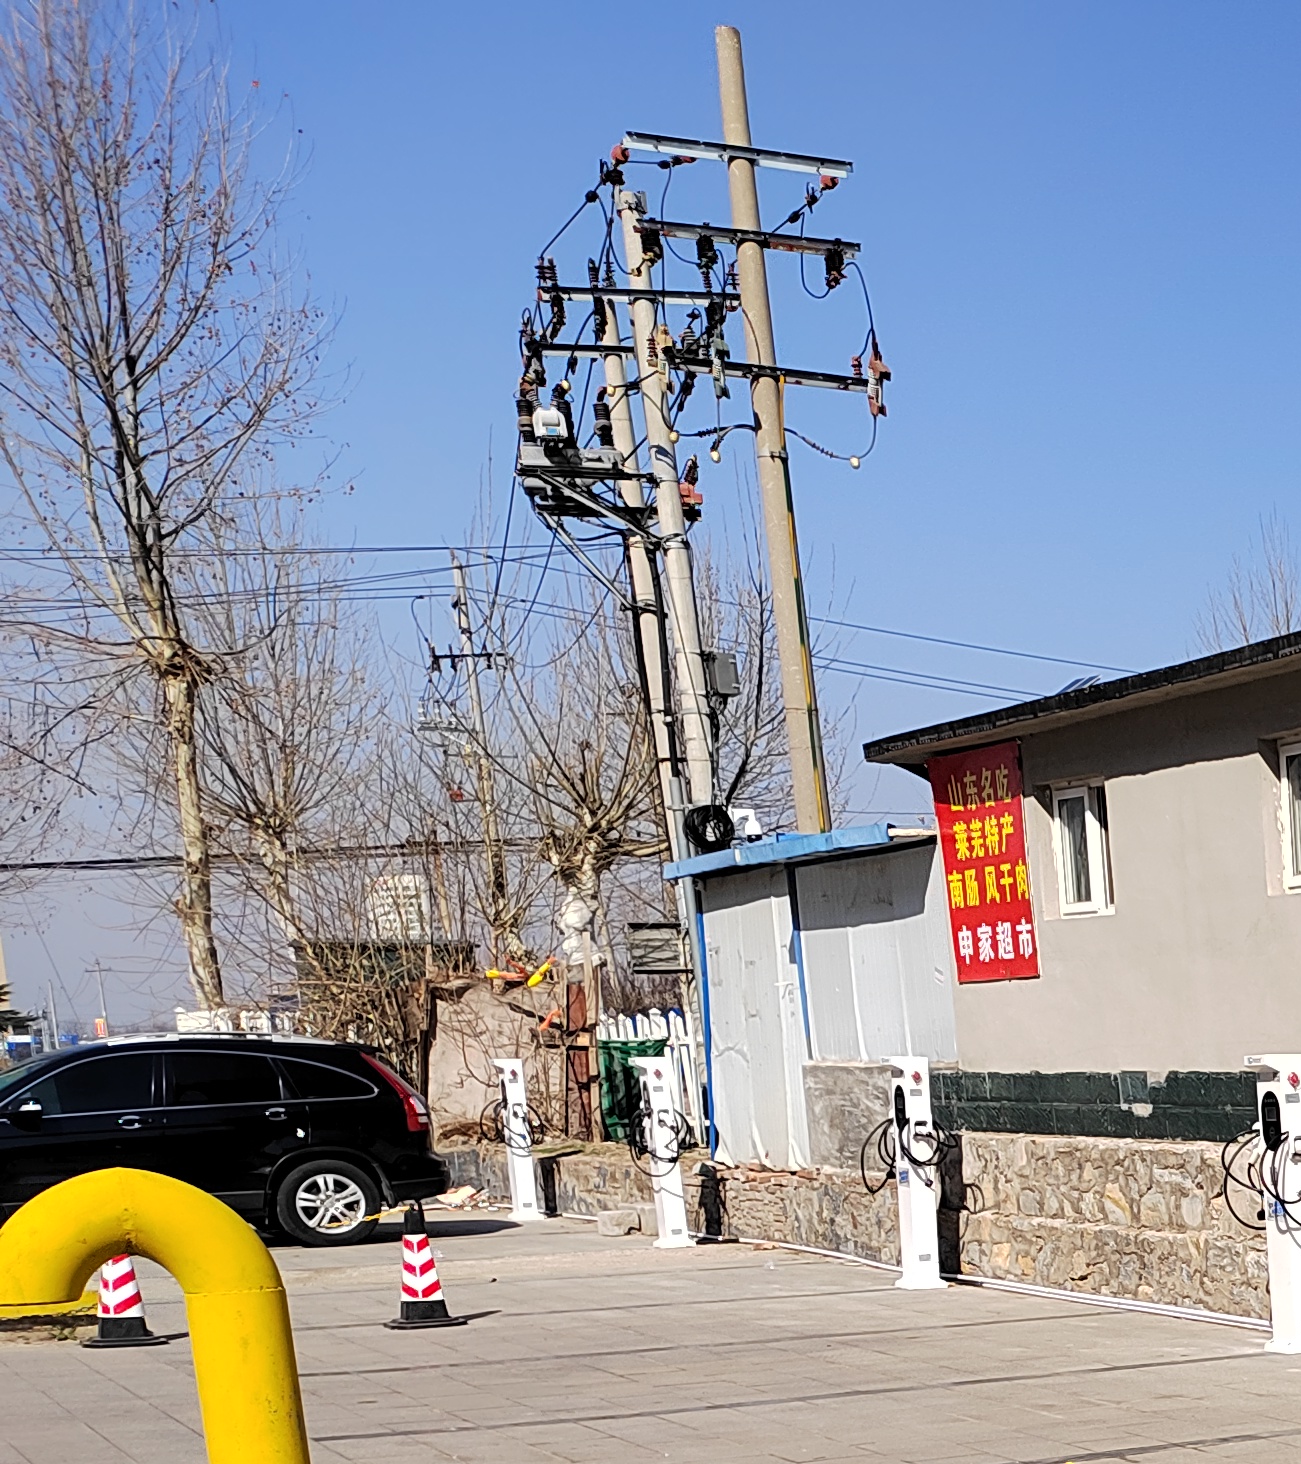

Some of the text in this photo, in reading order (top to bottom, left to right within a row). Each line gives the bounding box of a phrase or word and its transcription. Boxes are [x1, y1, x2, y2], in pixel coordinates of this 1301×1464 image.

[947, 763, 1012, 811] 山东名吃
[953, 812, 1014, 861] 莱芜特产
[947, 858, 1028, 909] 南肠 风干肉
[958, 916, 1033, 965] 申家超市
